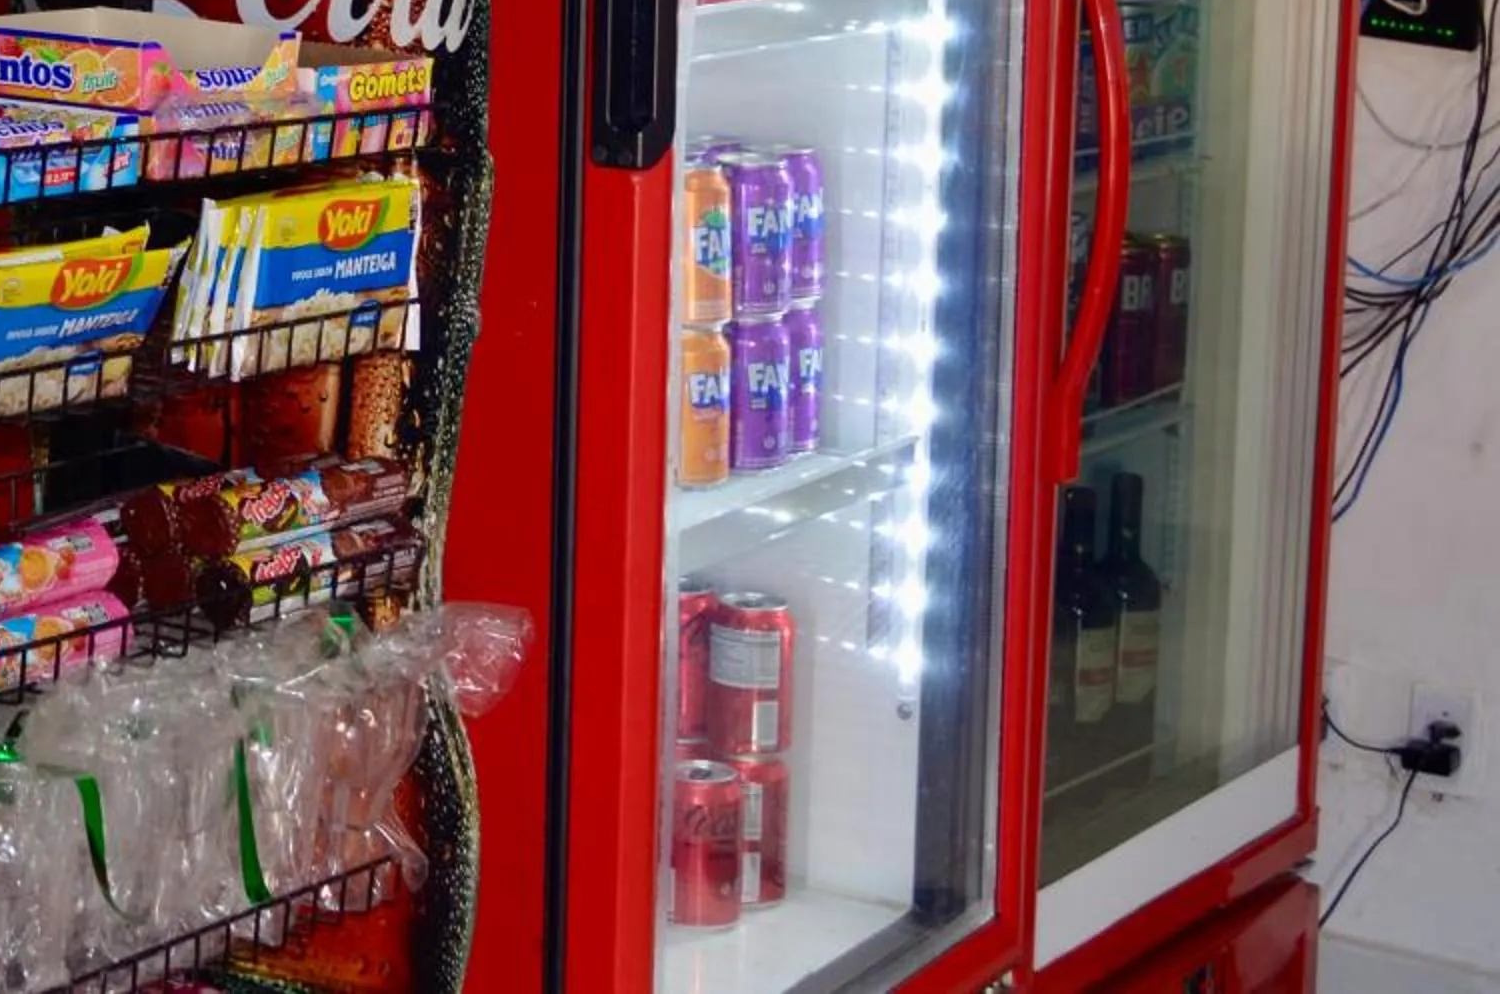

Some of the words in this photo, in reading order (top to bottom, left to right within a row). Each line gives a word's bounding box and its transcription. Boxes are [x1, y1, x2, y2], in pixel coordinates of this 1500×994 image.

[349, 61, 428, 102] Gomets
[325, 202, 372, 240] Yoki
[62, 260, 121, 299] Yoki
[334, 250, 397, 279] MANTEIGA
